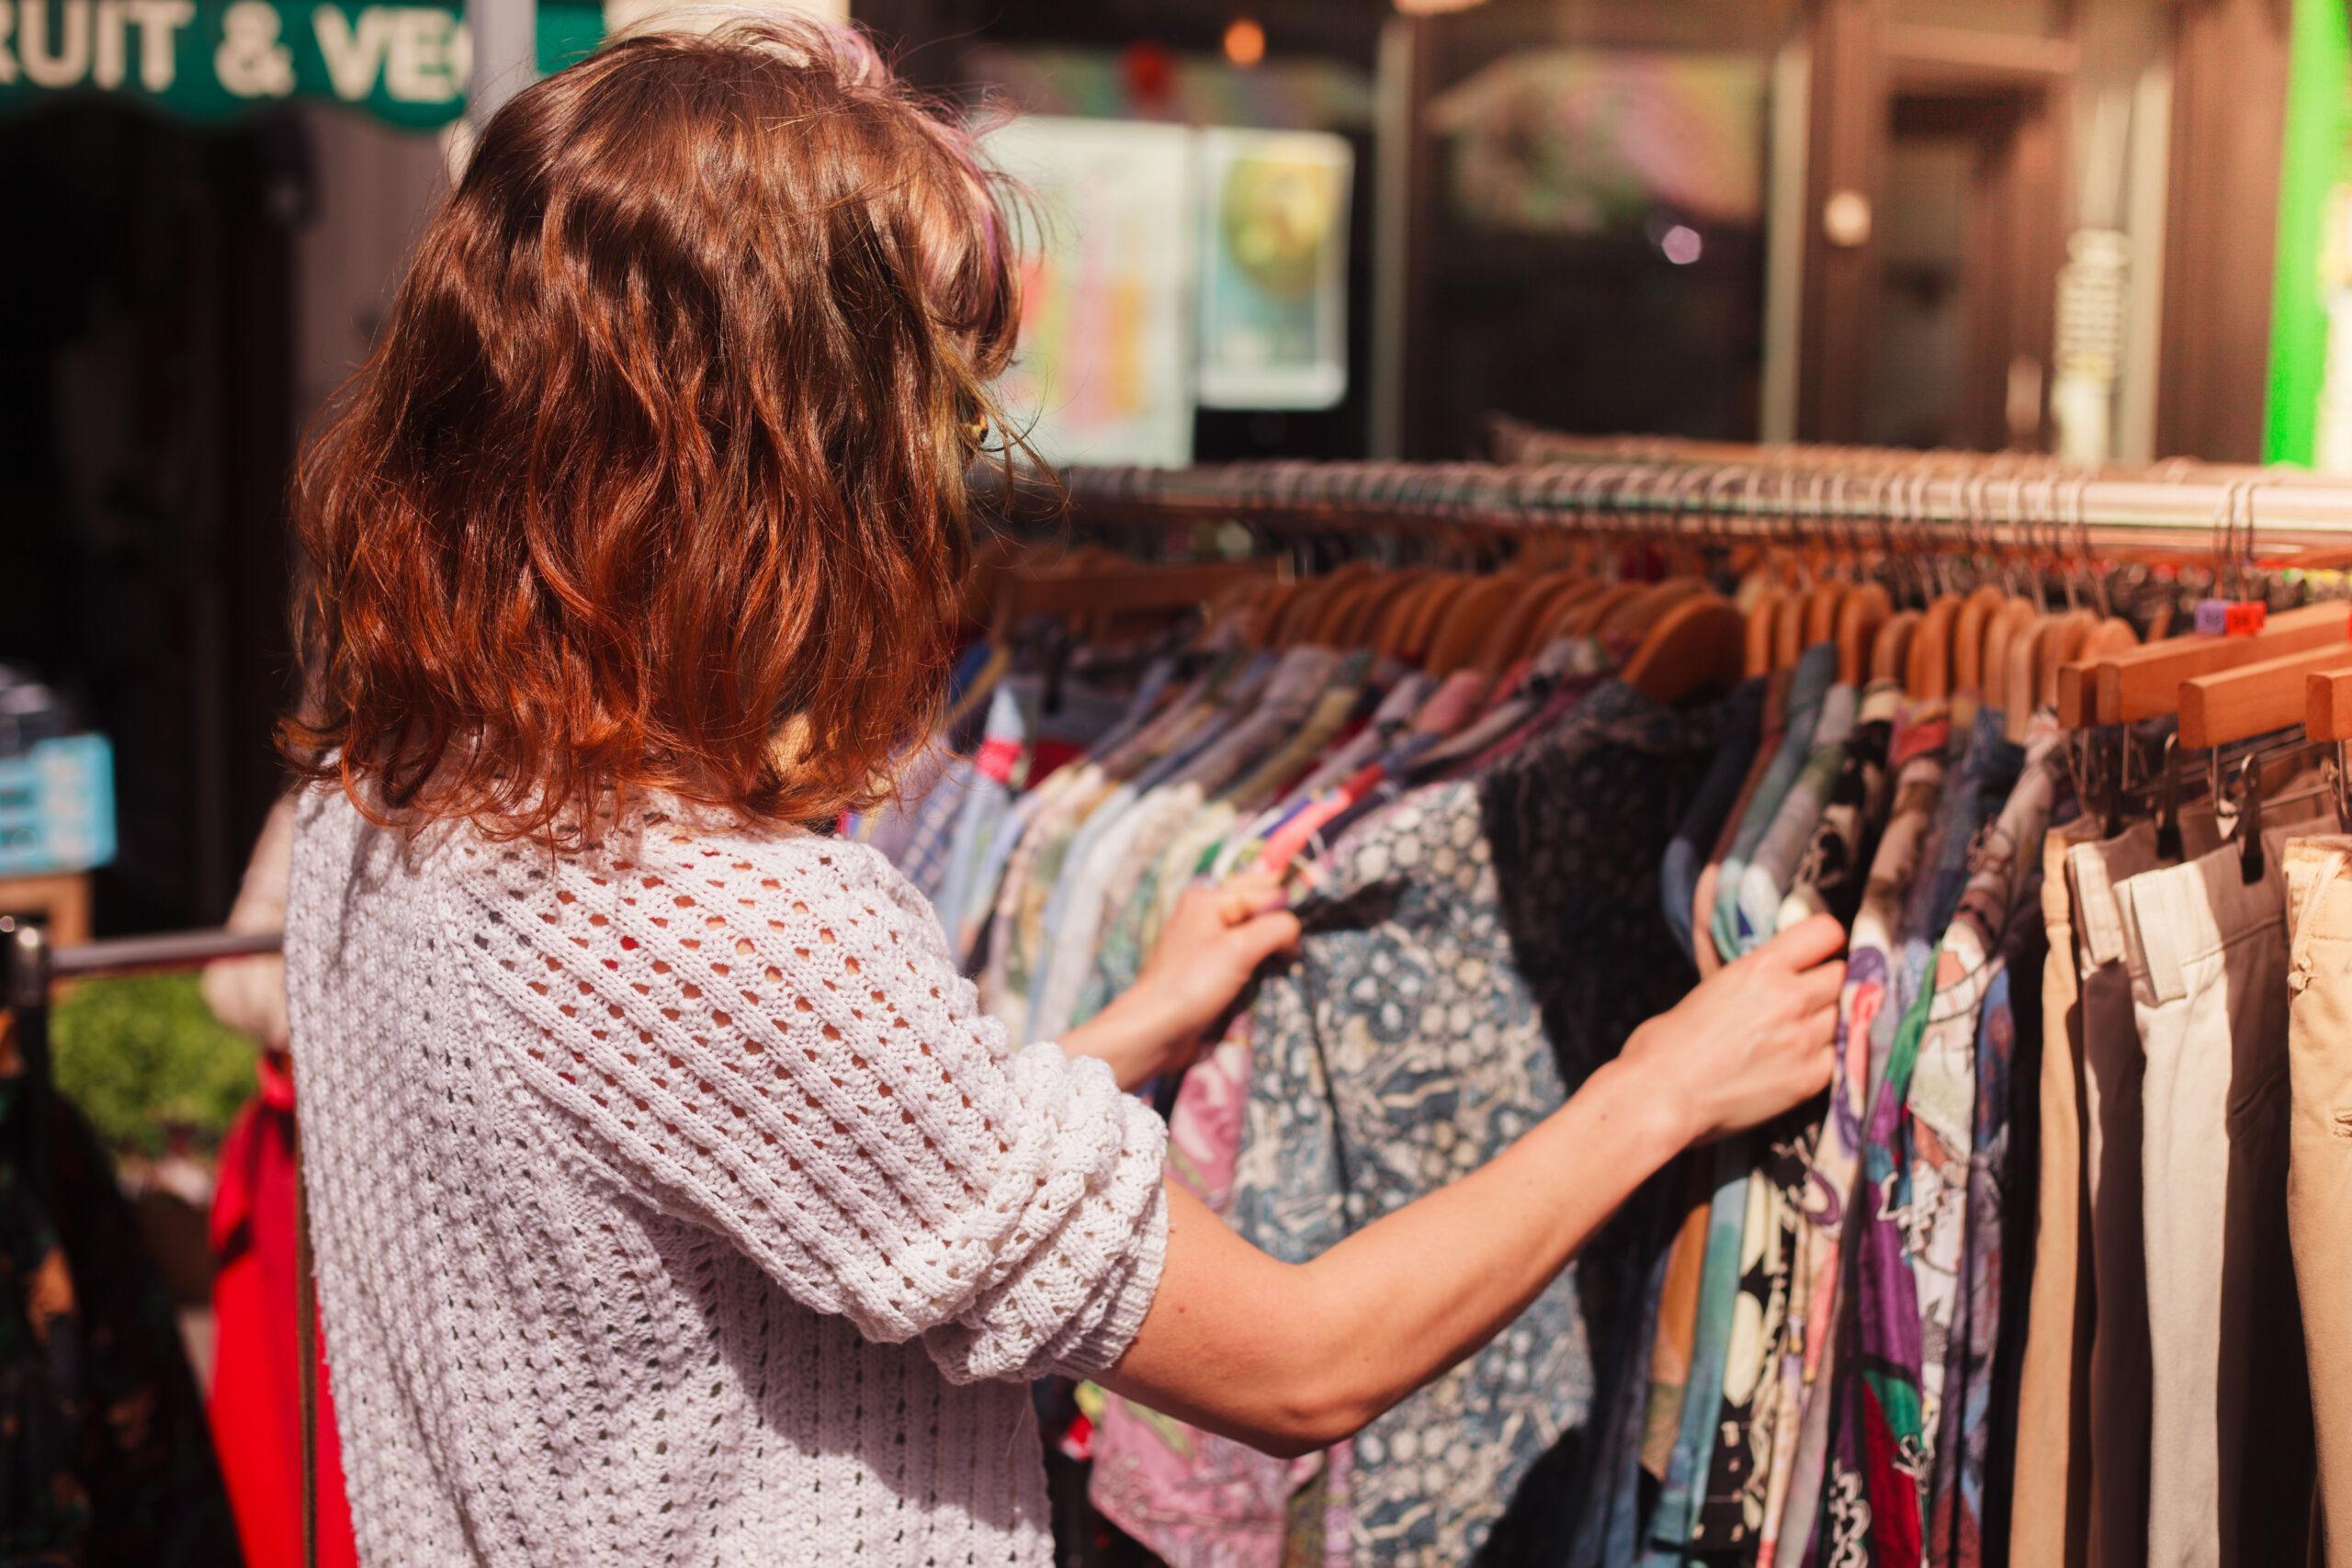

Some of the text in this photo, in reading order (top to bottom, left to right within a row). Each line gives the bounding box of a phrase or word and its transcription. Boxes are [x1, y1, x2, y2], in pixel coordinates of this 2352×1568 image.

[0, 0, 474, 103] UIT & VE
